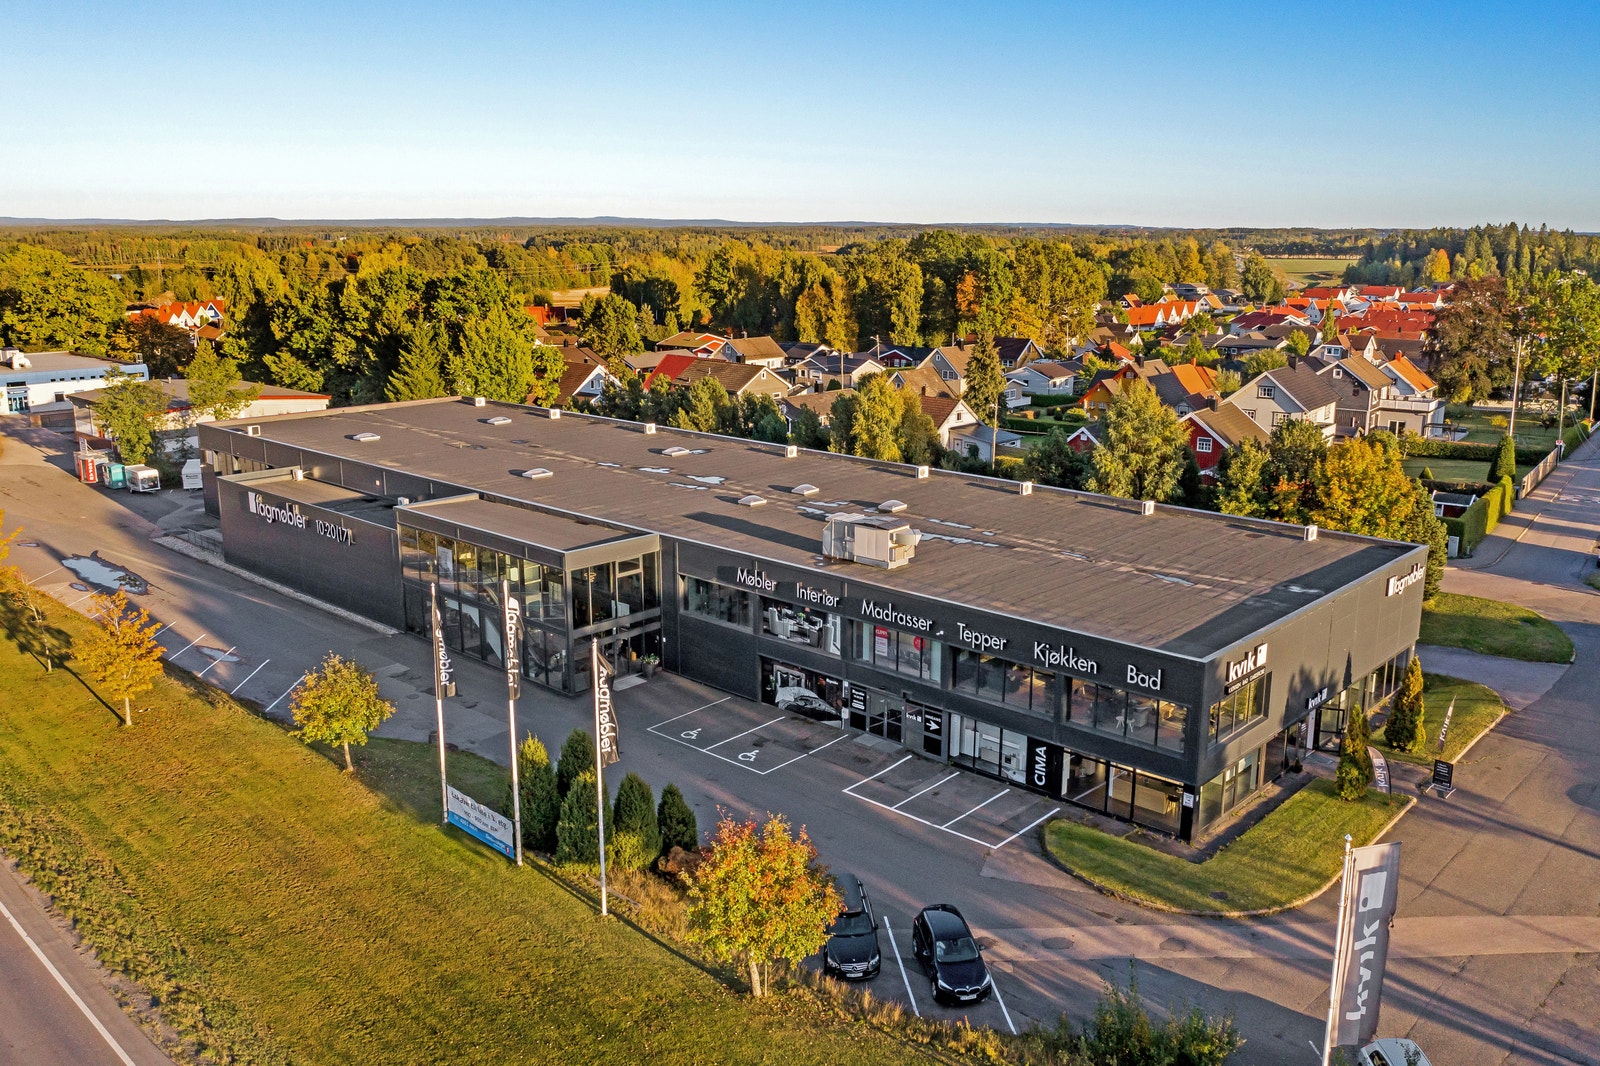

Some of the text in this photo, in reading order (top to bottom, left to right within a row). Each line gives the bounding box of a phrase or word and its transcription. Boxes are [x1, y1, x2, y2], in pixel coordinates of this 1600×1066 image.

[255, 494, 306, 529] fagmøbler
[736, 568, 777, 591] Møbler
[796, 582, 840, 608] Interiør
[861, 599, 933, 631] Madrasser
[956, 622, 1007, 651] Tepper
[1033, 641, 1098, 674] Kjøkken
[1126, 664, 1162, 691] Bad
[1228, 651, 1256, 683] kvik
[1308, 692, 1322, 709] kvik
[1034, 746, 1048, 786] CIMA
[1345, 919, 1380, 1021] kvik
